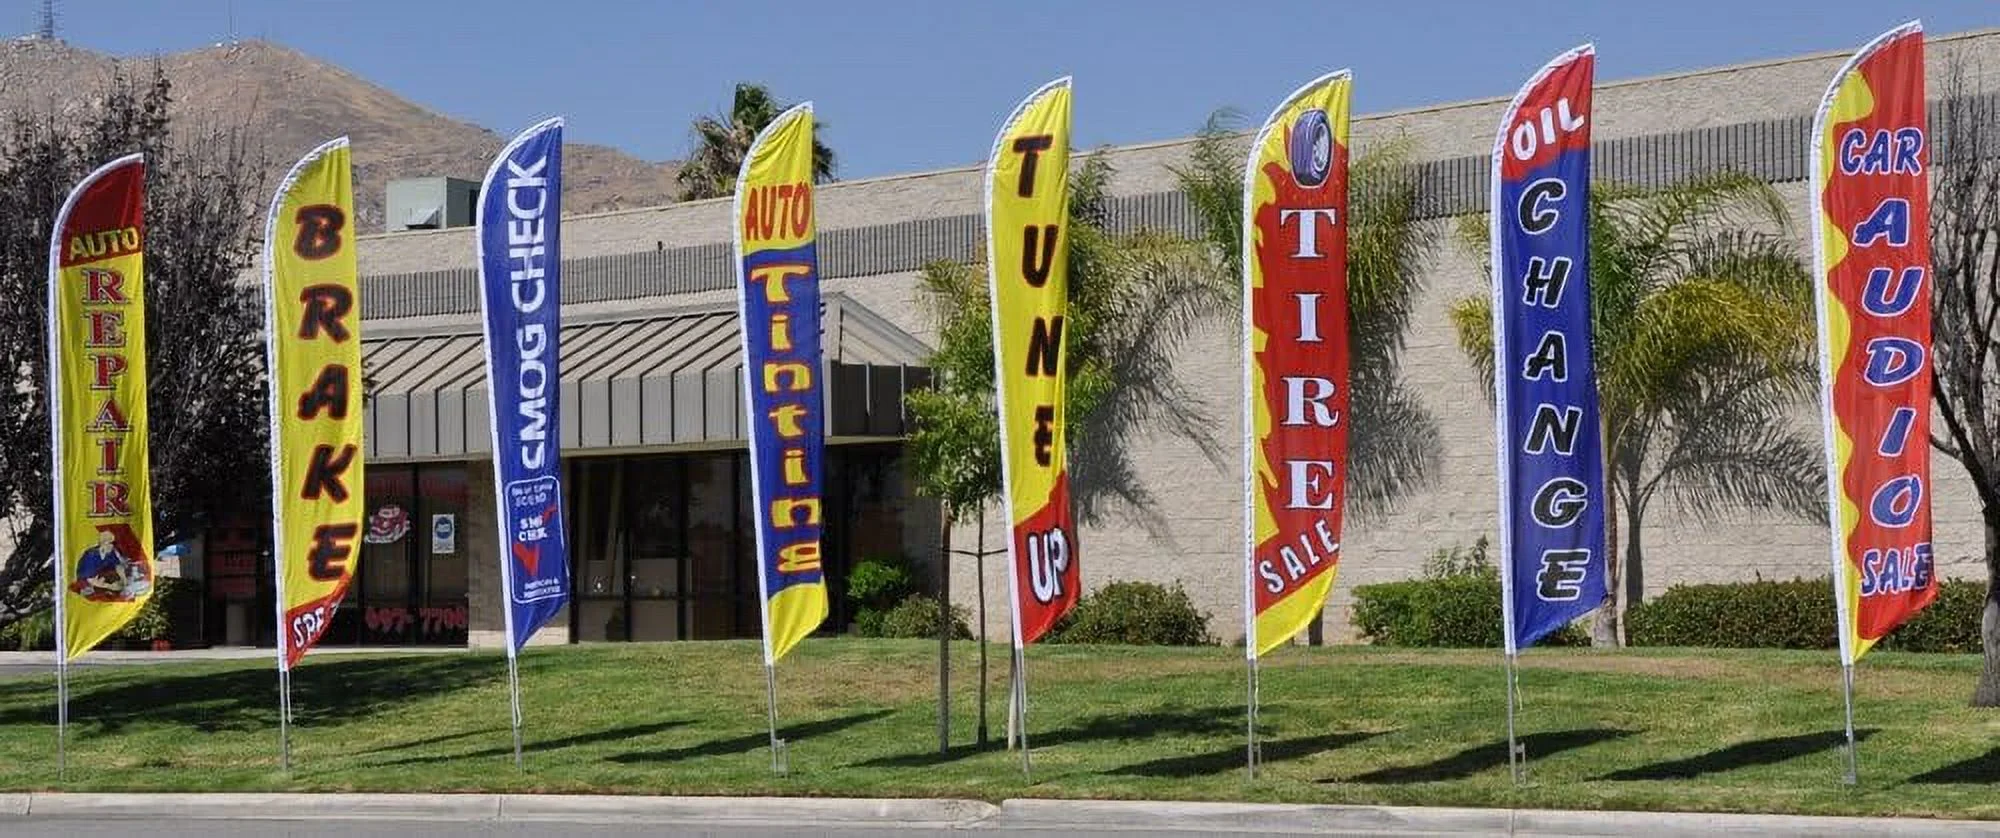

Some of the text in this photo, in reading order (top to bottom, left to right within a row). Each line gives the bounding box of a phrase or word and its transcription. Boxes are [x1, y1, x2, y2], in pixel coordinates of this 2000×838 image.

[1512, 98, 1584, 161] OIL
[1840, 127, 1924, 175] CAR
[67, 229, 139, 260] AUTO
[507, 155, 548, 314] CHECK
[745, 183, 813, 241] AUTO
[1013, 134, 1064, 468] TUNE
[1279, 207, 1339, 512] TIRE
[1853, 197, 1925, 528] AUDIO
[83, 267, 132, 517] REPAIR
[294, 204, 357, 583] BRAKE
[514, 322, 547, 470] SMOG
[750, 263, 823, 574] Tinting
[1517, 178, 1591, 601] CHANGE
[1027, 528, 1071, 603] UP
[1259, 520, 1339, 594] SALE
[1860, 541, 1933, 597] SALE
